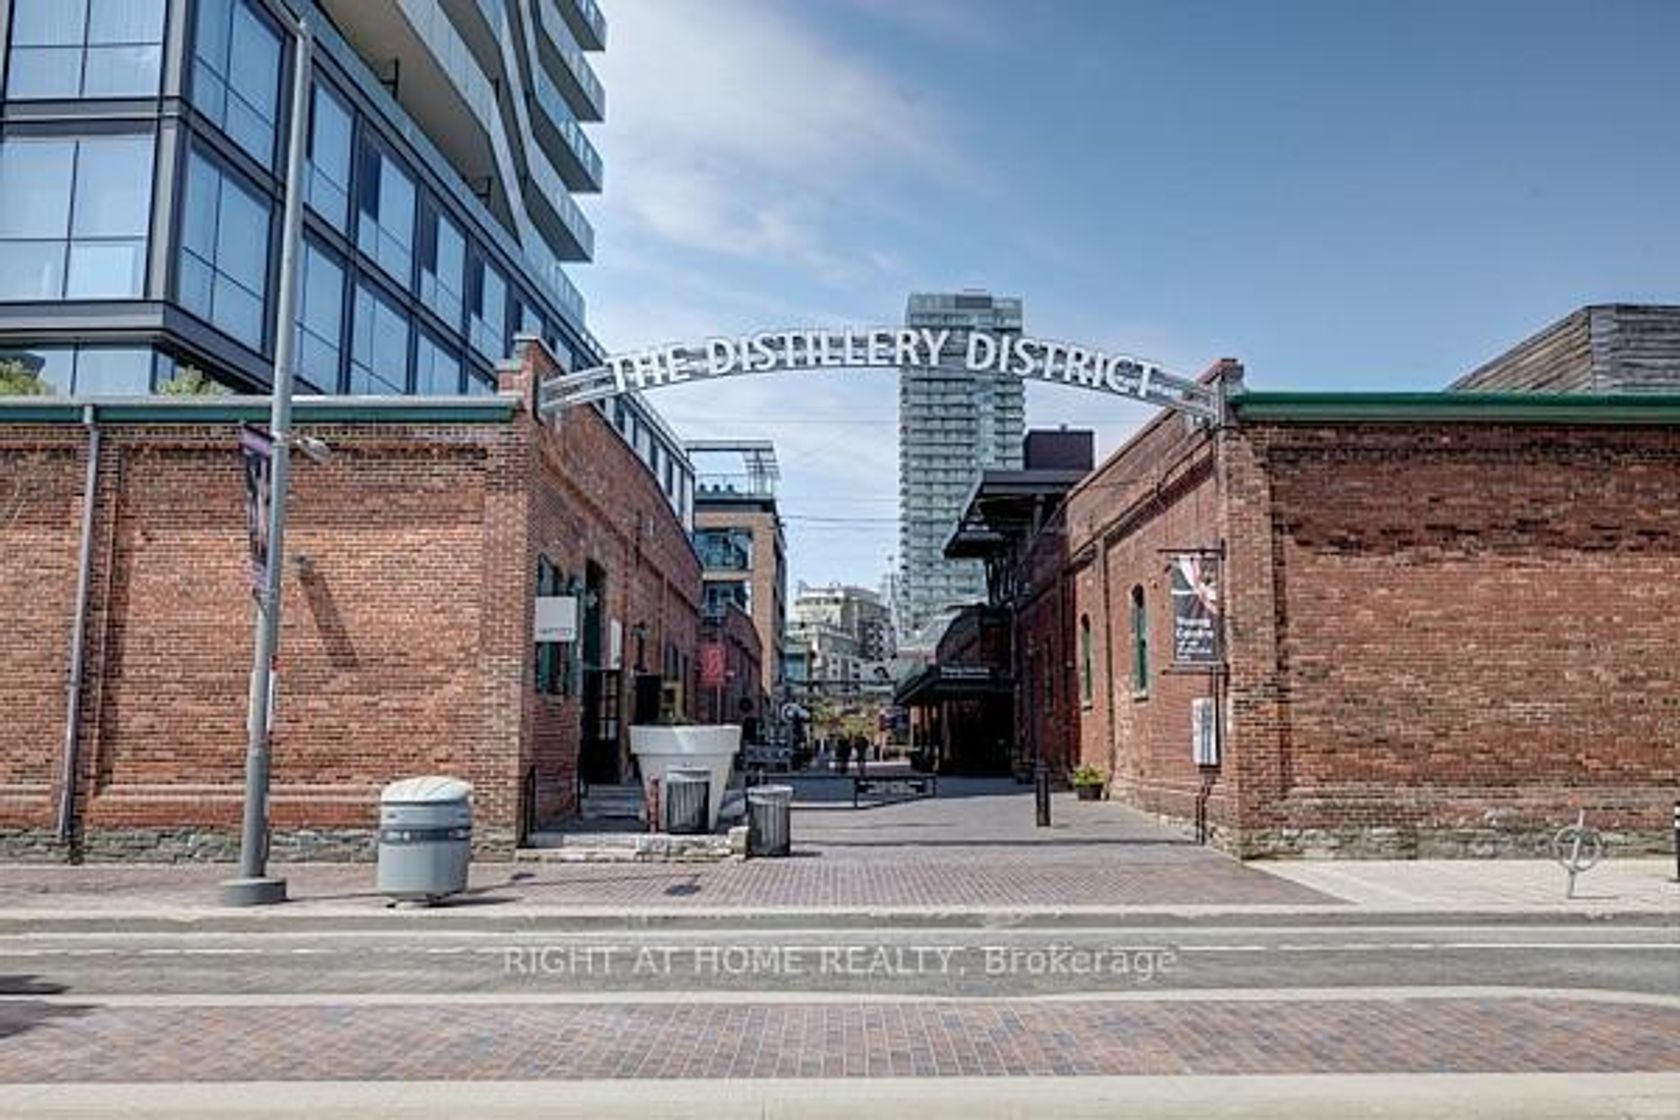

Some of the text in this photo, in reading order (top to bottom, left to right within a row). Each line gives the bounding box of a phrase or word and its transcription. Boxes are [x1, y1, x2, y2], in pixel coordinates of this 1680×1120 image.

[604, 329, 1160, 398] THE DISTILLERY DISTRICT
